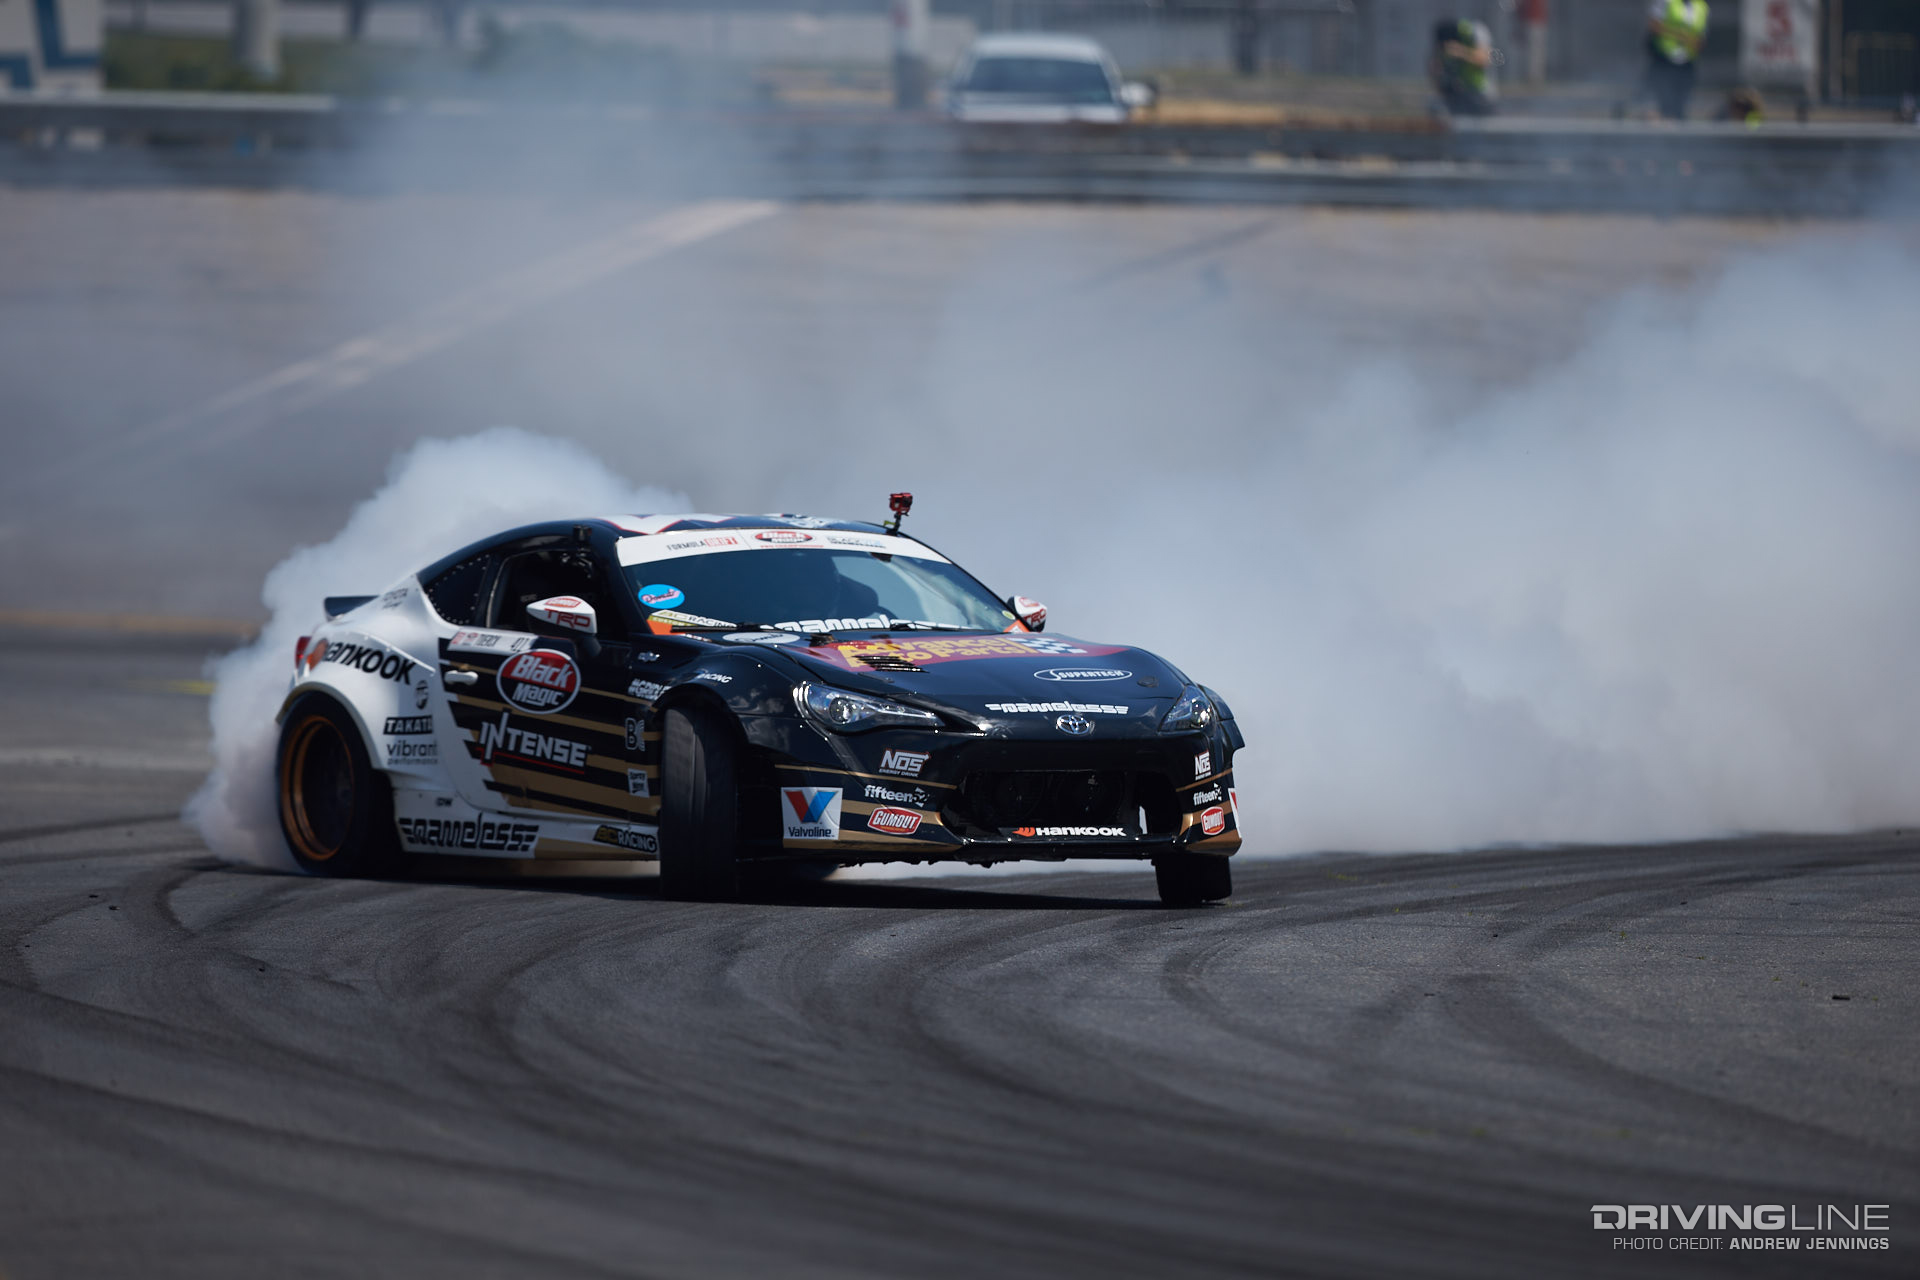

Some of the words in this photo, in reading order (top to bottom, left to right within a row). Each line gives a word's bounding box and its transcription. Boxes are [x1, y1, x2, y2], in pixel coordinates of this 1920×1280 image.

[667, 540, 706, 551] FORMULA
[544, 608, 591, 628] TRD
[1023, 608, 1047, 627] TRD
[927, 645, 1028, 658] Parts
[511, 654, 573, 689] Black
[512, 682, 565, 707] Magic
[387, 740, 438, 757] vibrant
[479, 712, 588, 767] INTENSE
[881, 750, 929, 773] NOS
[1194, 751, 1211, 776] NOS
[872, 810, 919, 829] GUMOUT
[617, 830, 657, 852] RACING
[788, 826, 833, 838] Valvoline
